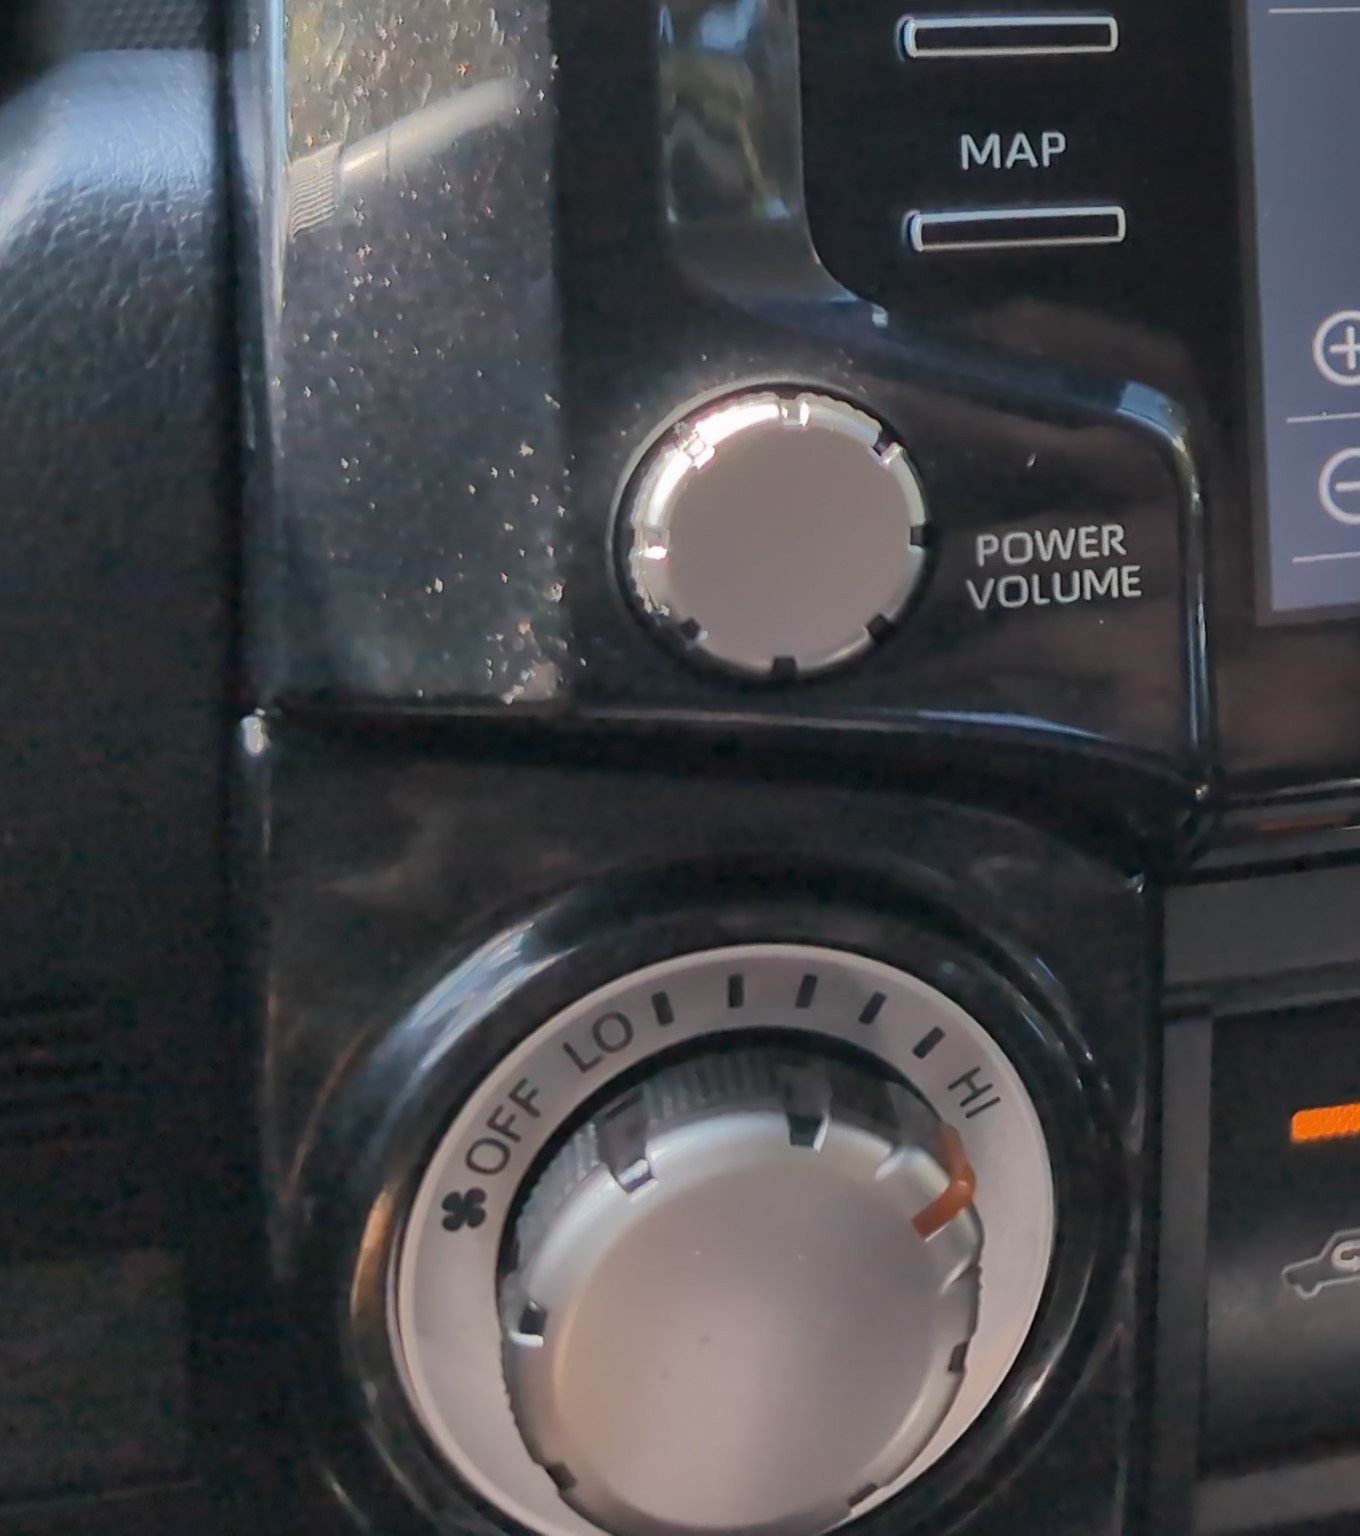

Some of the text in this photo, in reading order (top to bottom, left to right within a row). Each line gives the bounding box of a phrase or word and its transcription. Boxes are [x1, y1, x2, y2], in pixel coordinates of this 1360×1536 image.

[960, 131, 1067, 171] MAP
[975, 523, 1128, 568] POWER
[965, 564, 1143, 612] VOLUME
[561, 1010, 635, 1076] LO
[946, 1064, 1001, 1120] HI
[464, 1077, 543, 1177] OFF
